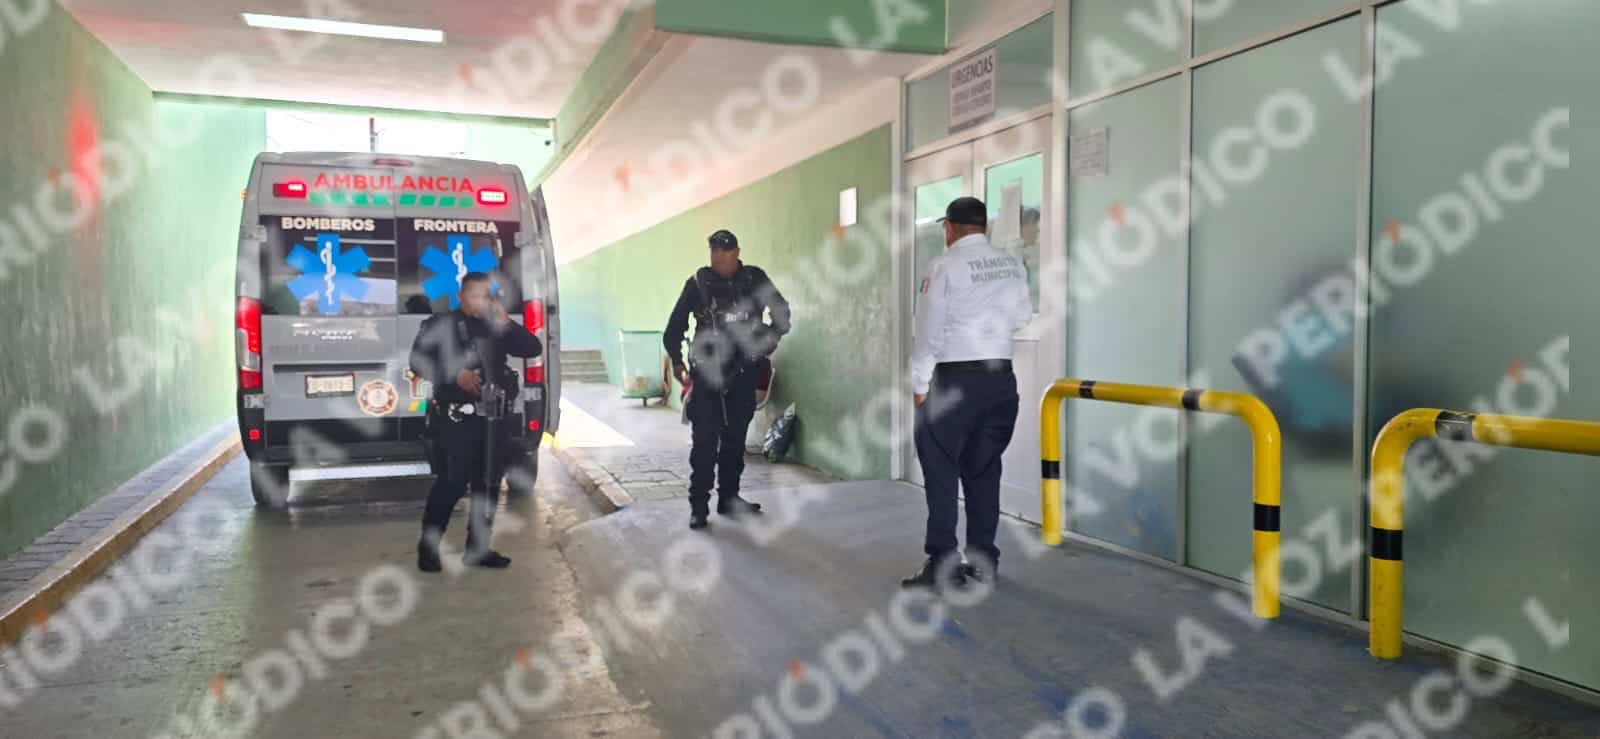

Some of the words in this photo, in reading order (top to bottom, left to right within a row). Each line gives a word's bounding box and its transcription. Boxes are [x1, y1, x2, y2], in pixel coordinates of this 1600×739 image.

[314, 172, 475, 194] AMBULANCIA
[281, 217, 376, 232] BOMBEROS
[413, 218, 499, 234] FRONTERA
